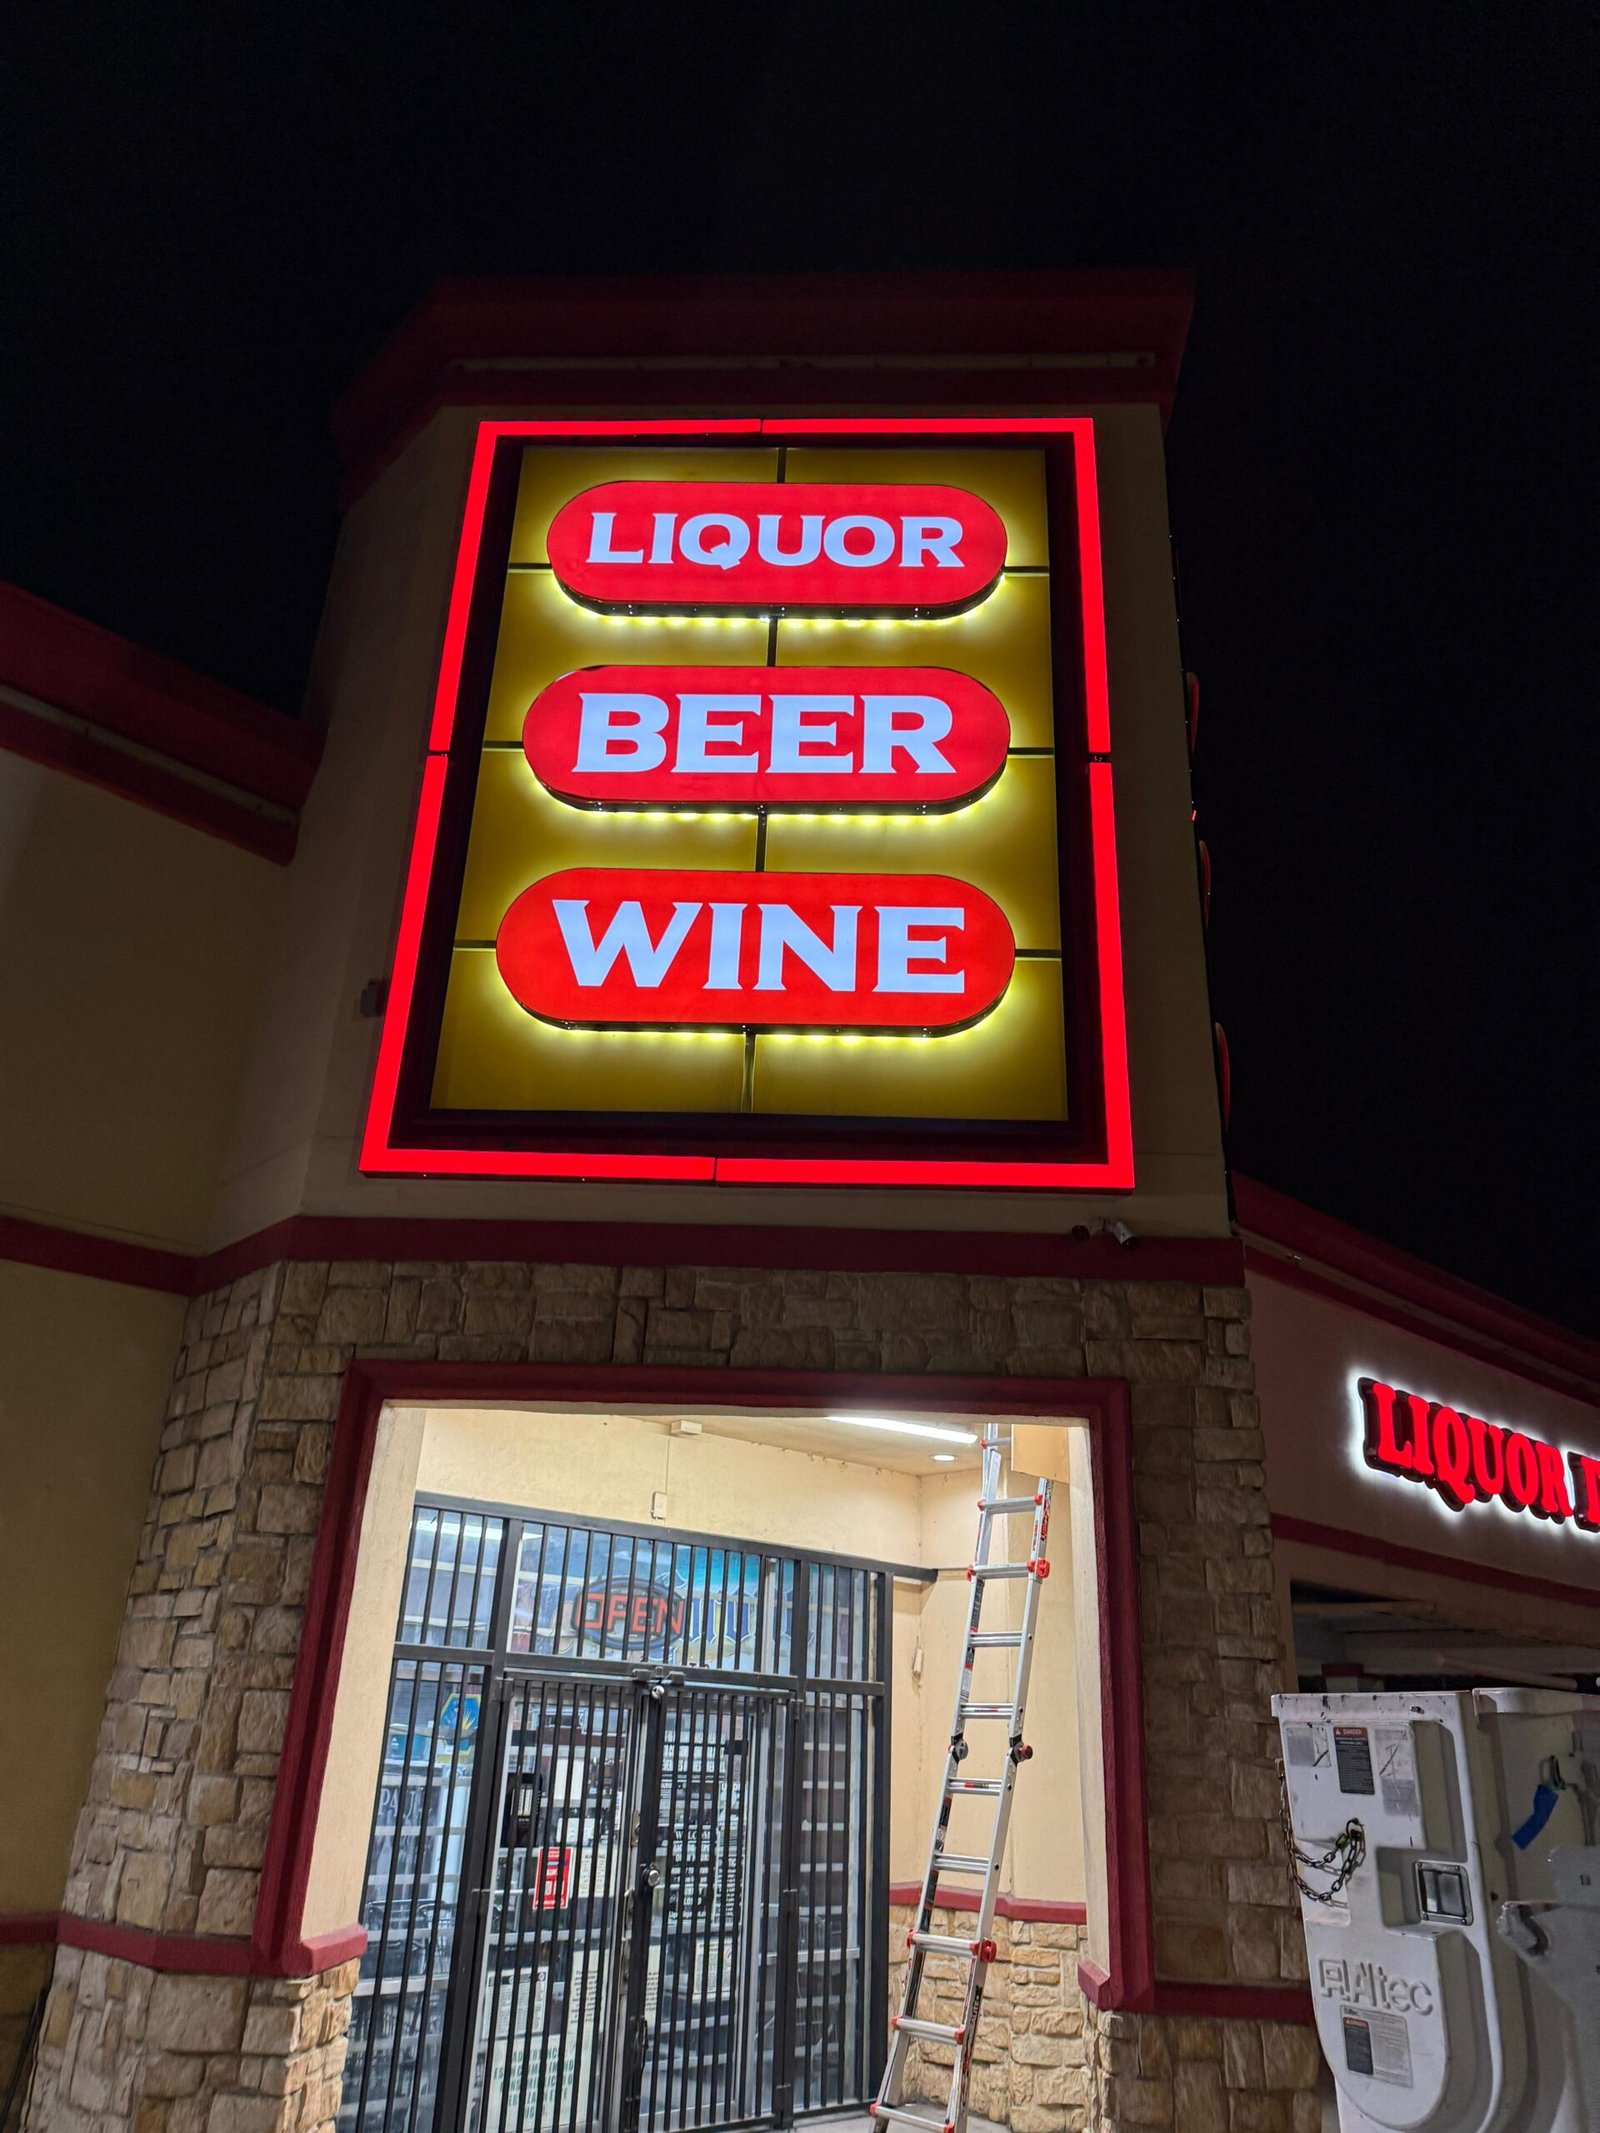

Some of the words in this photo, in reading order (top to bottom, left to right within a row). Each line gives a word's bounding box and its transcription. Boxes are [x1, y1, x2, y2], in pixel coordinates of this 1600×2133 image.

[586, 512, 965, 570] LIQUOR
[571, 692, 957, 774] BEER
[551, 899, 965, 994] WINE
[1370, 1380, 1574, 1518] LIQUOR
[574, 1592, 686, 1634] OPEN
[1353, 1961, 1435, 2016] Altec
